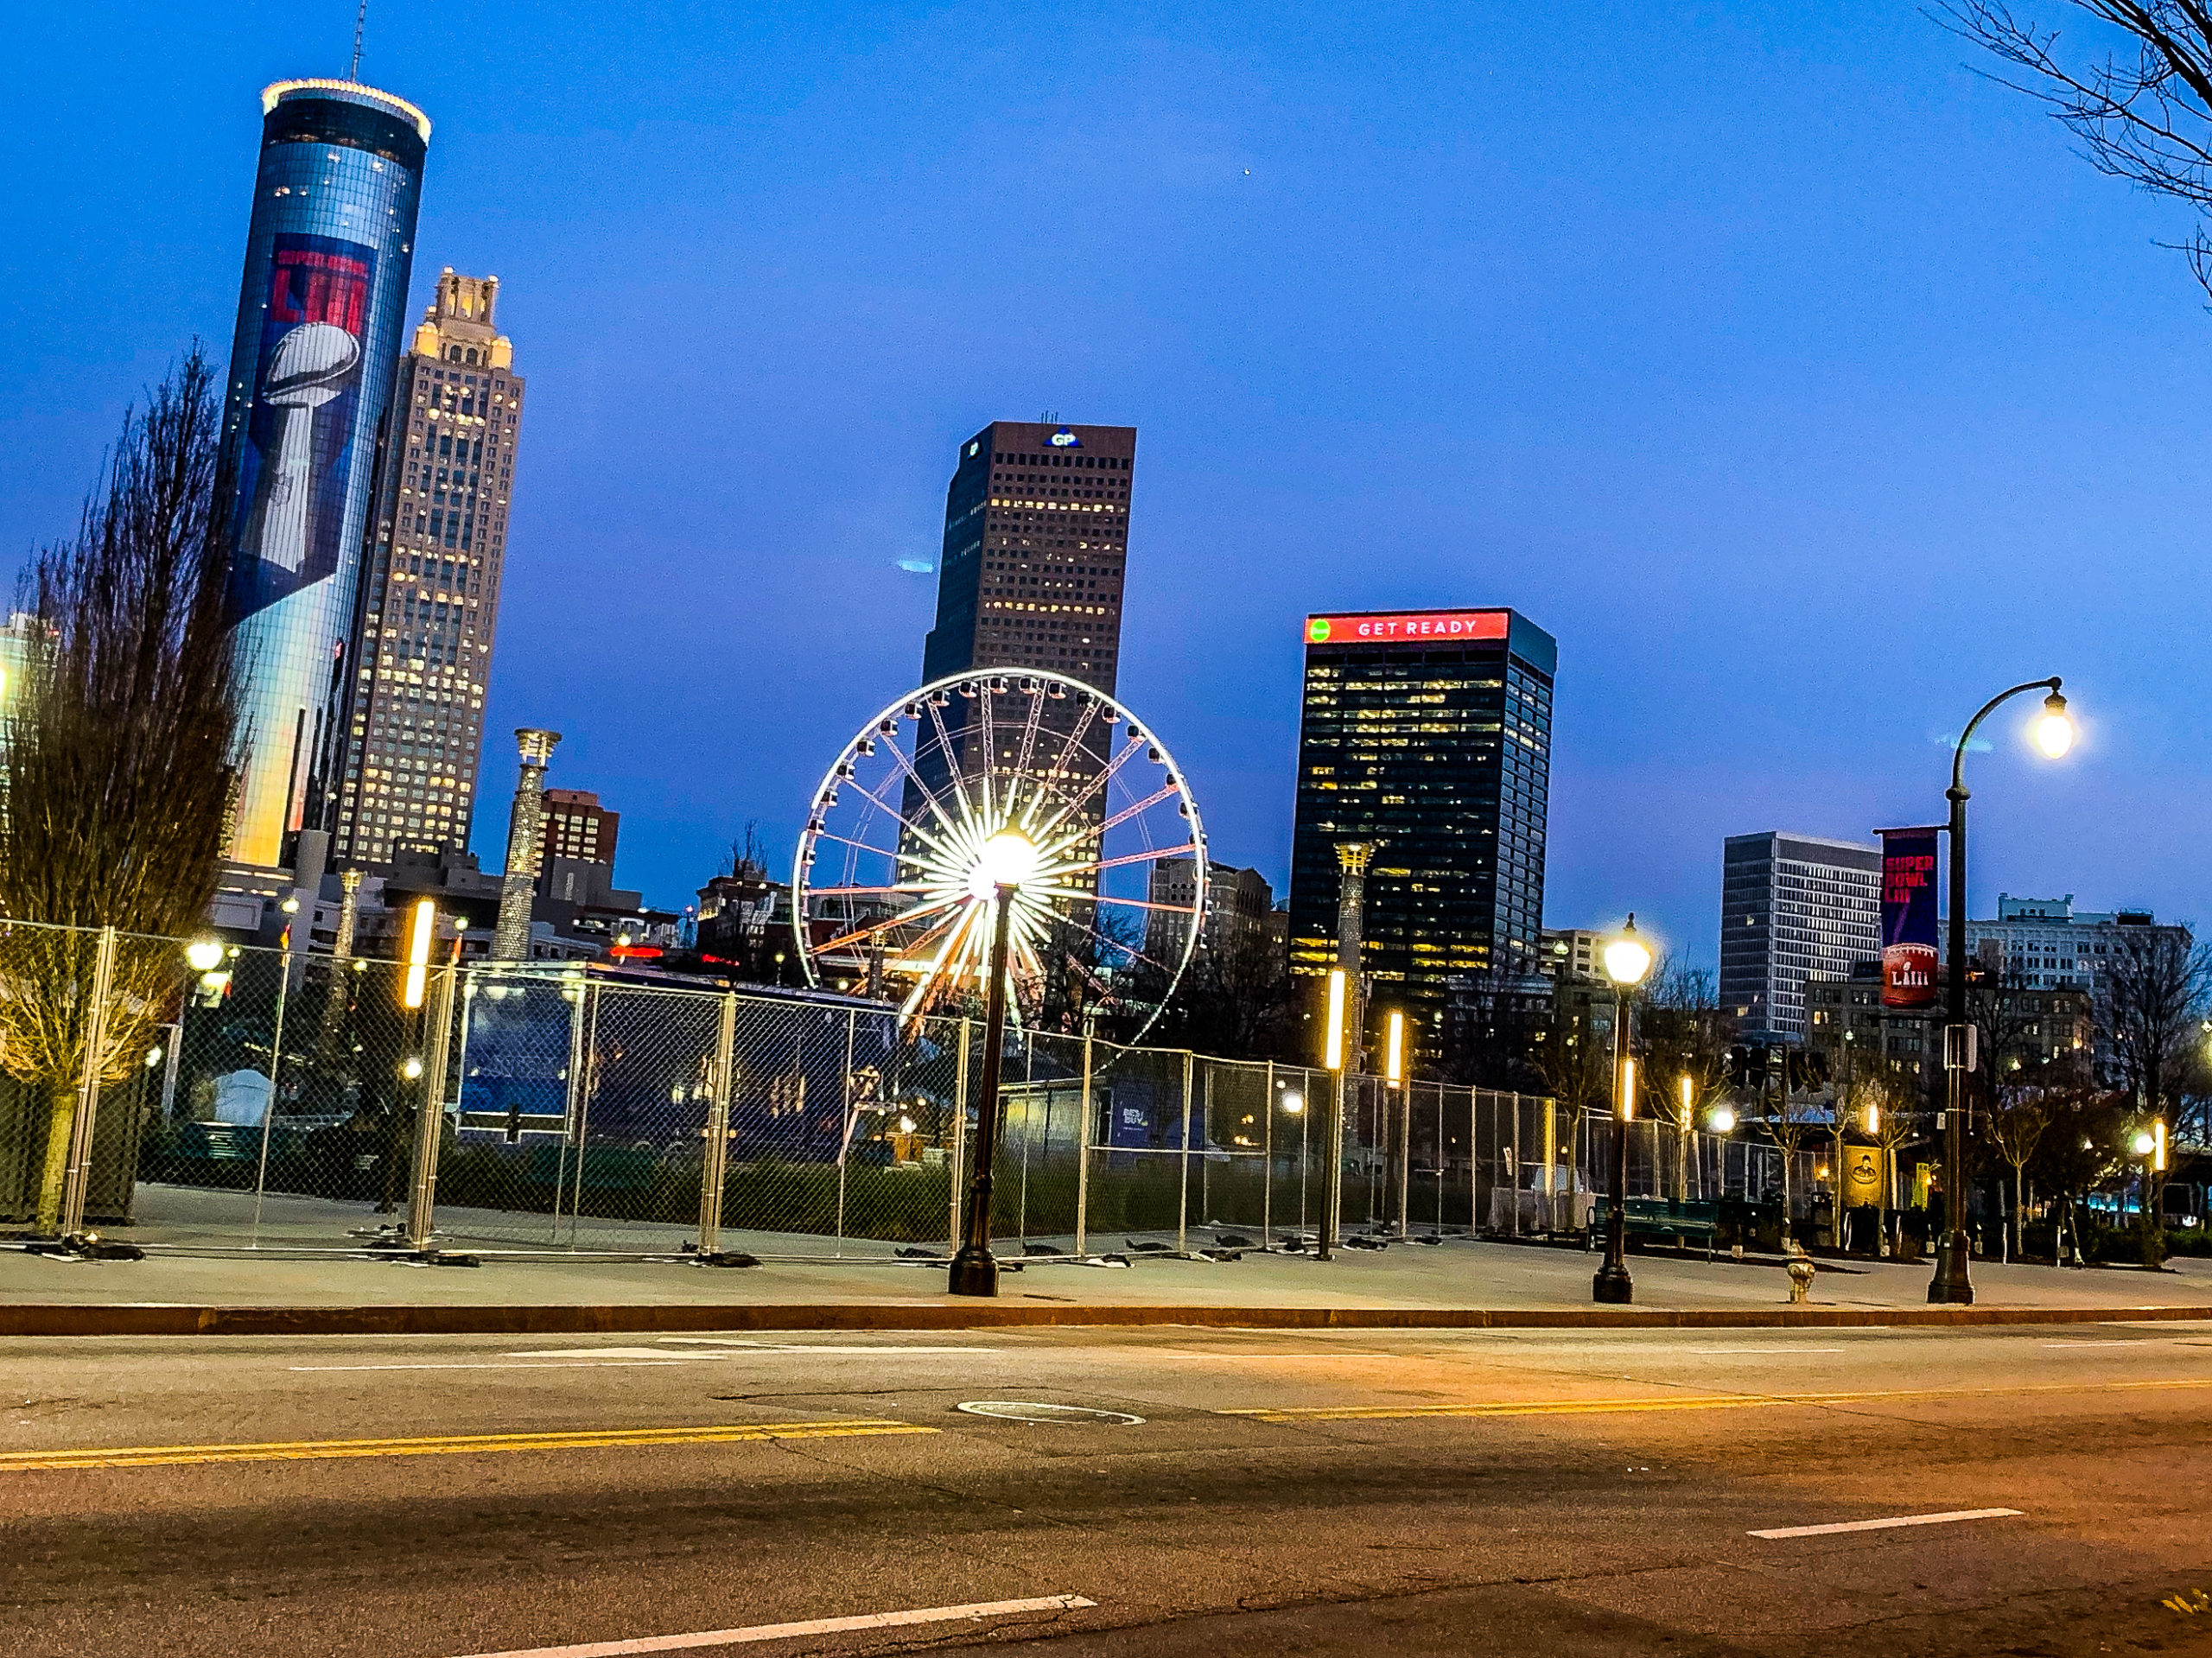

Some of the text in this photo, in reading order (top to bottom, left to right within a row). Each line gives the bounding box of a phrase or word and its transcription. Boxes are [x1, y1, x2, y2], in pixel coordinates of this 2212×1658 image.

[1052, 434, 1076, 446] GP
[1358, 620, 1476, 636] GET READY
[1886, 856, 1934, 871] SUPER
[1885, 872, 1928, 886] BOWL
[1124, 1115, 1144, 1124] BUY
